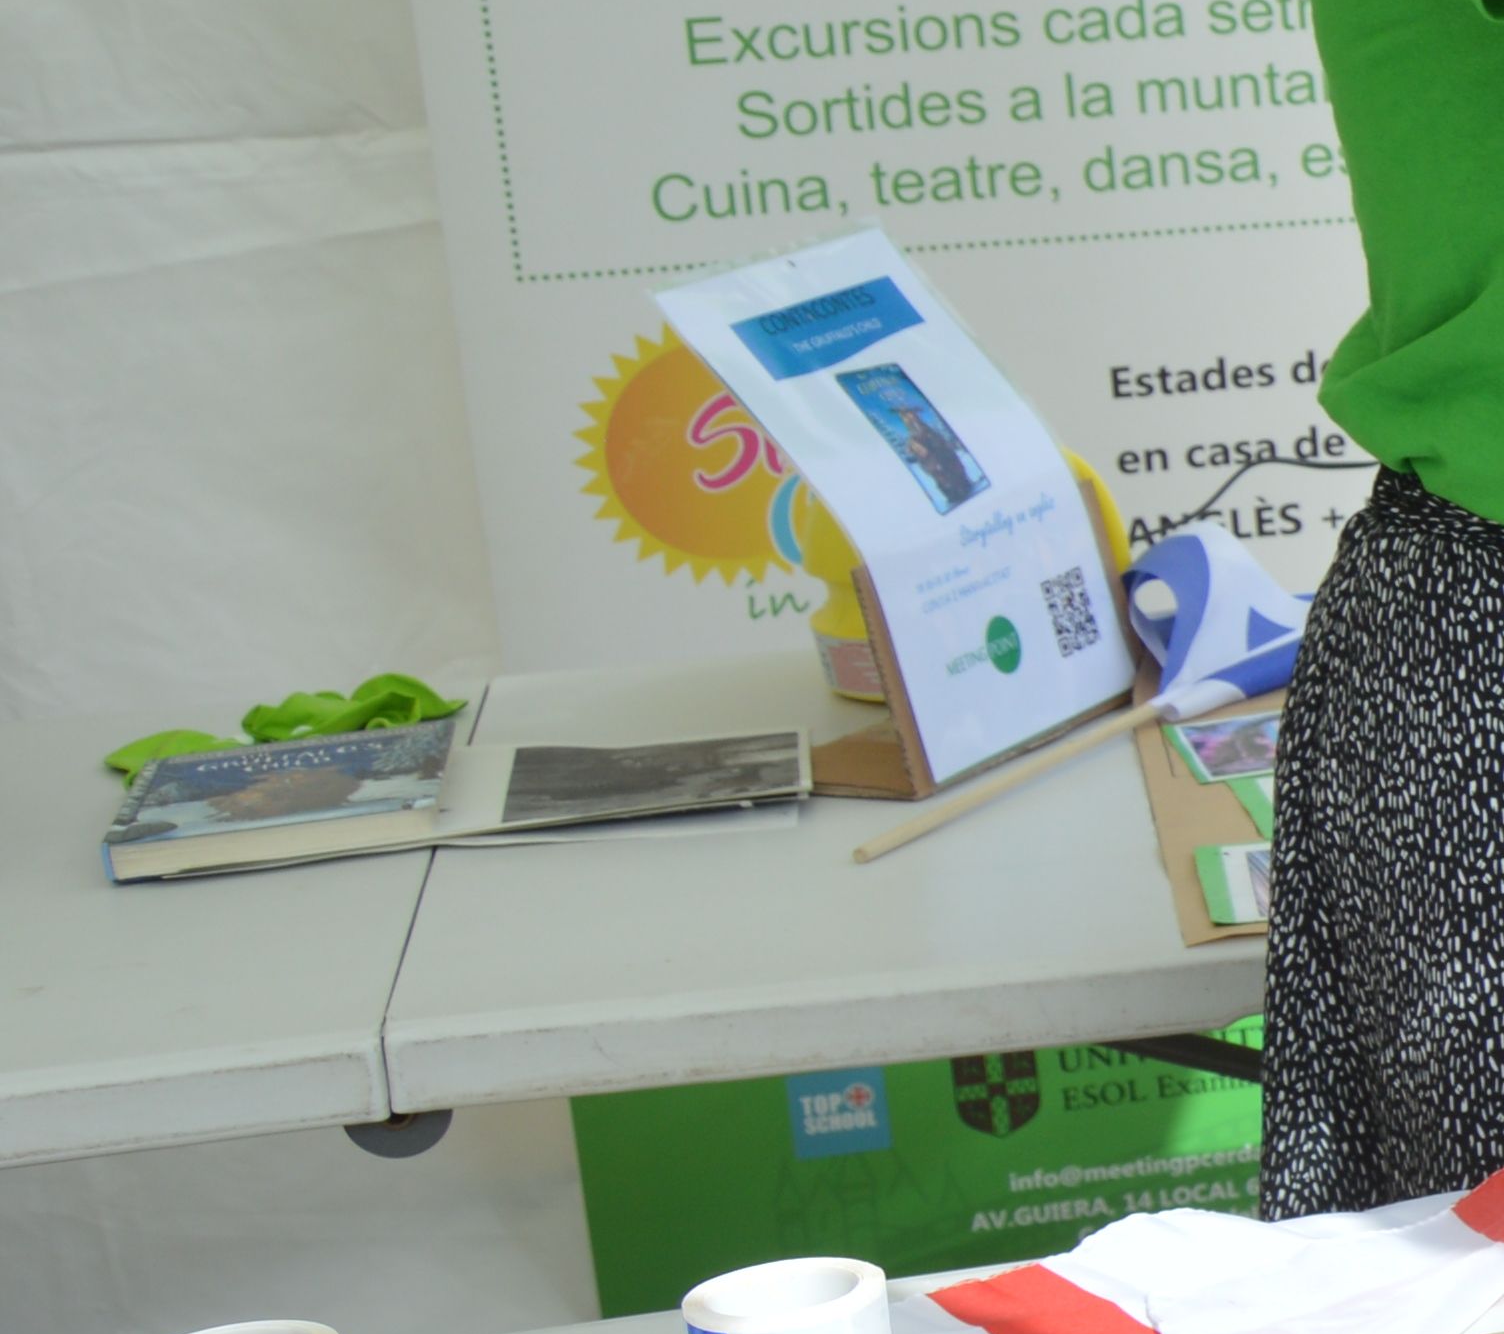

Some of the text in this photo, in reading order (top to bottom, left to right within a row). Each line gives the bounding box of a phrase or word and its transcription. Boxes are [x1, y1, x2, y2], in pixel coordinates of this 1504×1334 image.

[685, 10, 1020, 66] Excursions
[737, 62, 1332, 140] Sortides a la munta
[651, 155, 847, 223] Cuina,
[870, 151, 1061, 204] teatre,
[1084, 145, 1278, 193] dansa,
[1110, 357, 1275, 399] Estades
[1117, 426, 1345, 474] en casa de
[746, 579, 810, 619] in
[800, 1094, 842, 1117] TOP
[1062, 1079, 1146, 1111] ESOL
[803, 1108, 877, 1136] SCHOOL
[1124, 1191, 1153, 1213] 14
[1160, 1181, 1239, 1207] LOCAL
